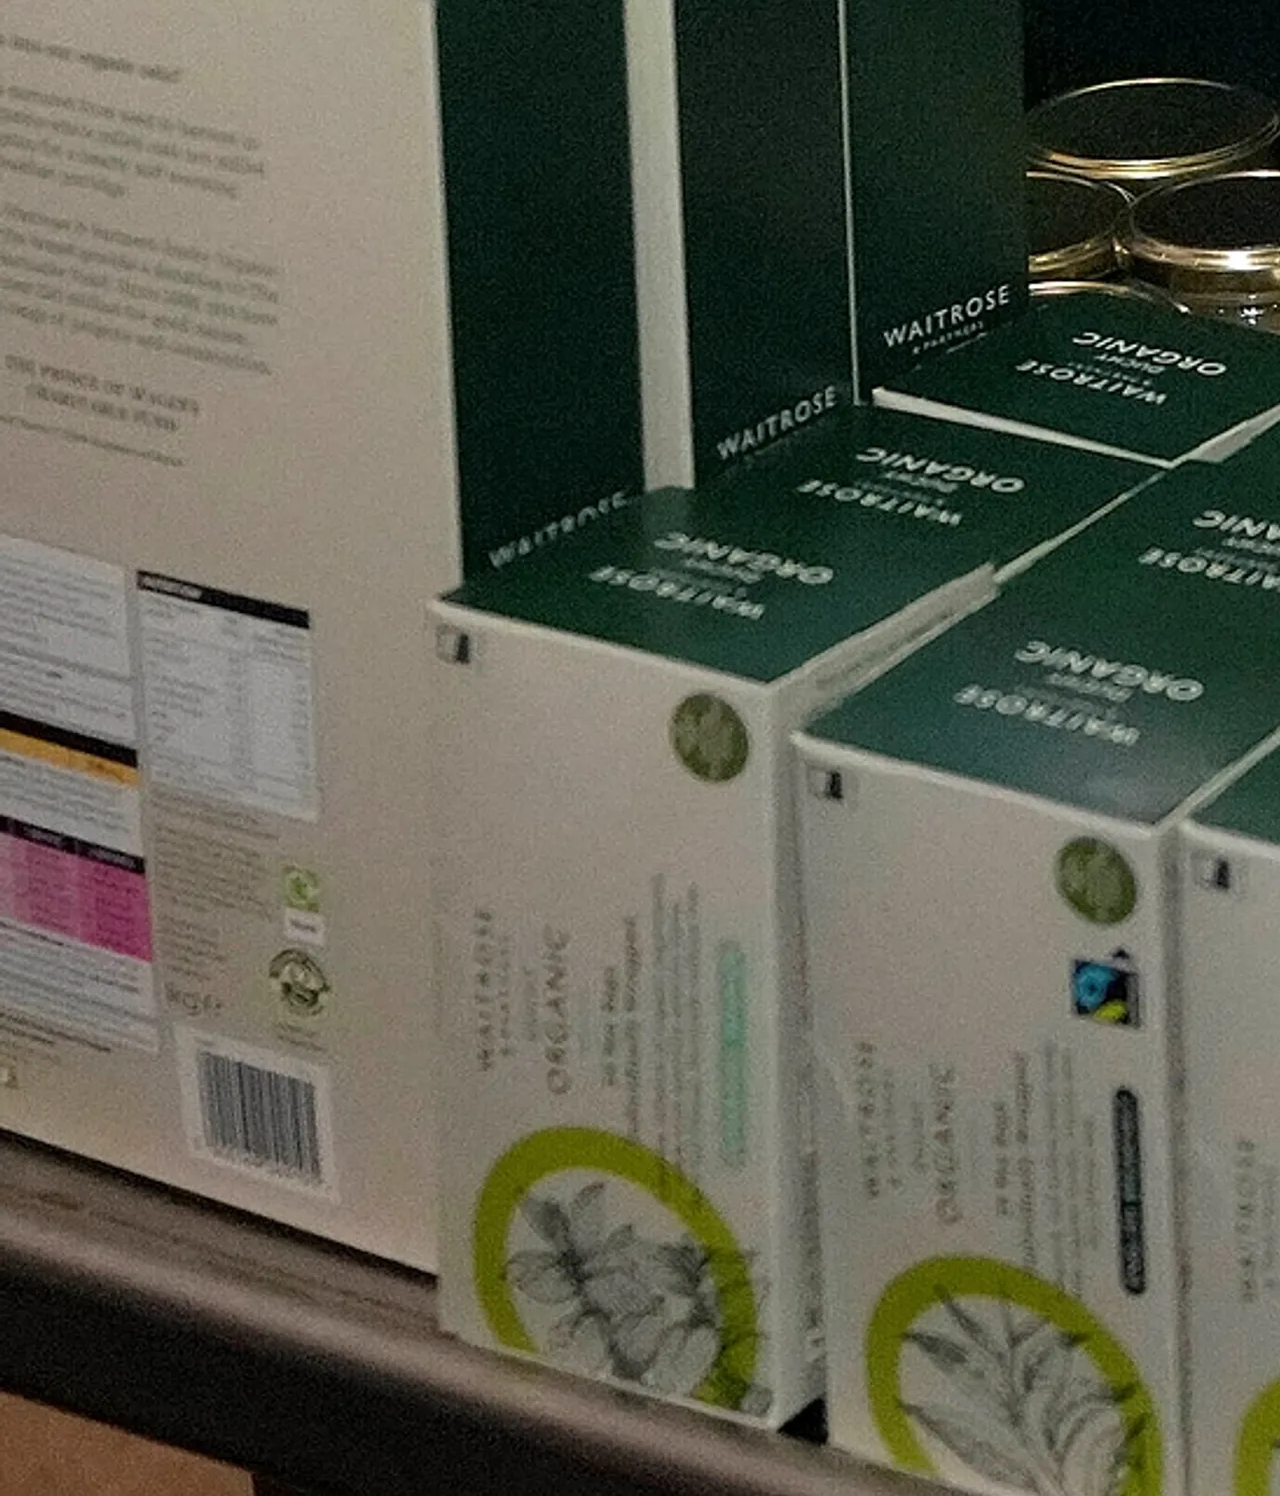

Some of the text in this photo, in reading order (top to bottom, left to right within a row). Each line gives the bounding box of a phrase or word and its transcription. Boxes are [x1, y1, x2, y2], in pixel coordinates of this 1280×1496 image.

[884, 285, 1009, 348] WAITROSE
[1015, 360, 1167, 405] WAITROSE
[1072, 331, 1226, 377] ORGANIC
[716, 385, 837, 461] WAITROSE
[856, 447, 1025, 493] ORGANIC
[797, 479, 963, 526] WAITROSE
[1014, 640, 1204, 701] ORGANIC
[953, 683, 1140, 746] WAITROSE
[542, 923, 570, 1096] ORGANIC
